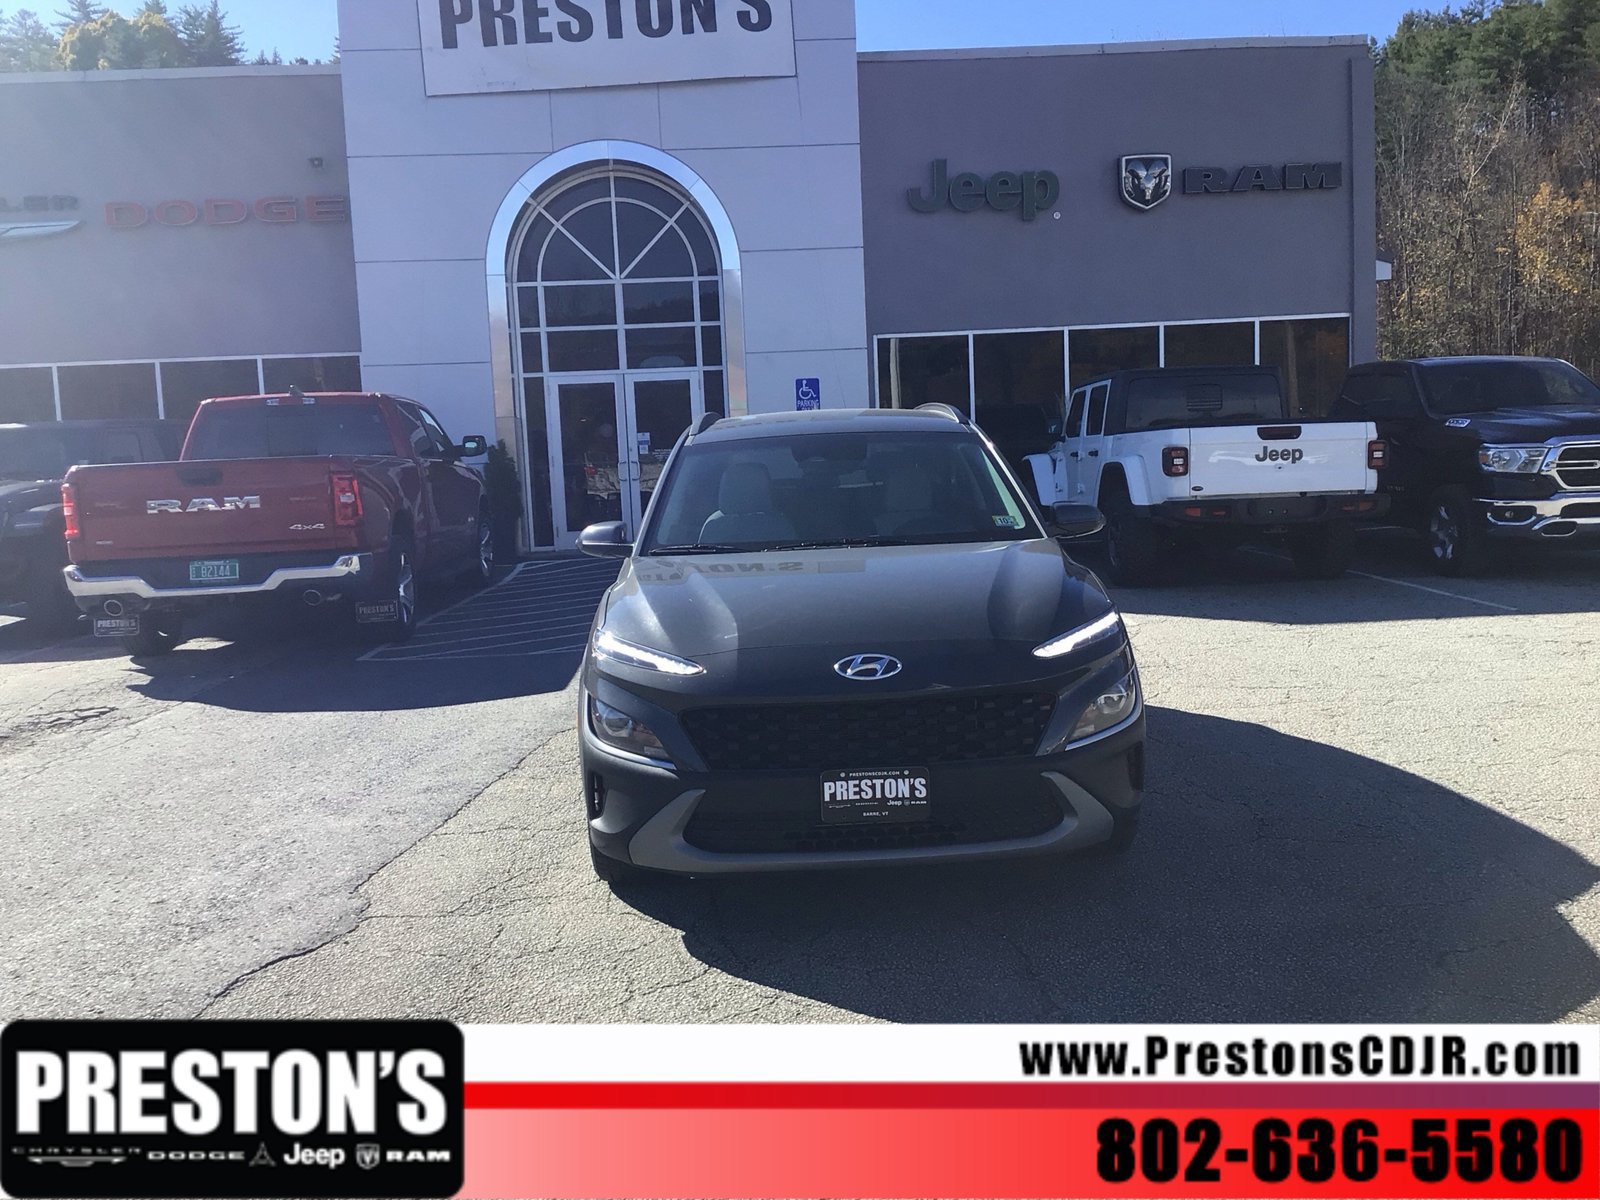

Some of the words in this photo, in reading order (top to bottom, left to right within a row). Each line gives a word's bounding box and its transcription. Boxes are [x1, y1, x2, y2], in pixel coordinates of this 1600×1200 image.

[439, 0, 773, 49] PRESTONS
[906, 158, 1061, 221] Jeep
[1182, 161, 1342, 194] RAM
[104, 194, 346, 227] DODGE
[1254, 445, 1304, 465] Jeep
[146, 495, 261, 514] RAM
[289, 523, 326, 531] 4x4
[823, 777, 927, 801] PRESTON'S
